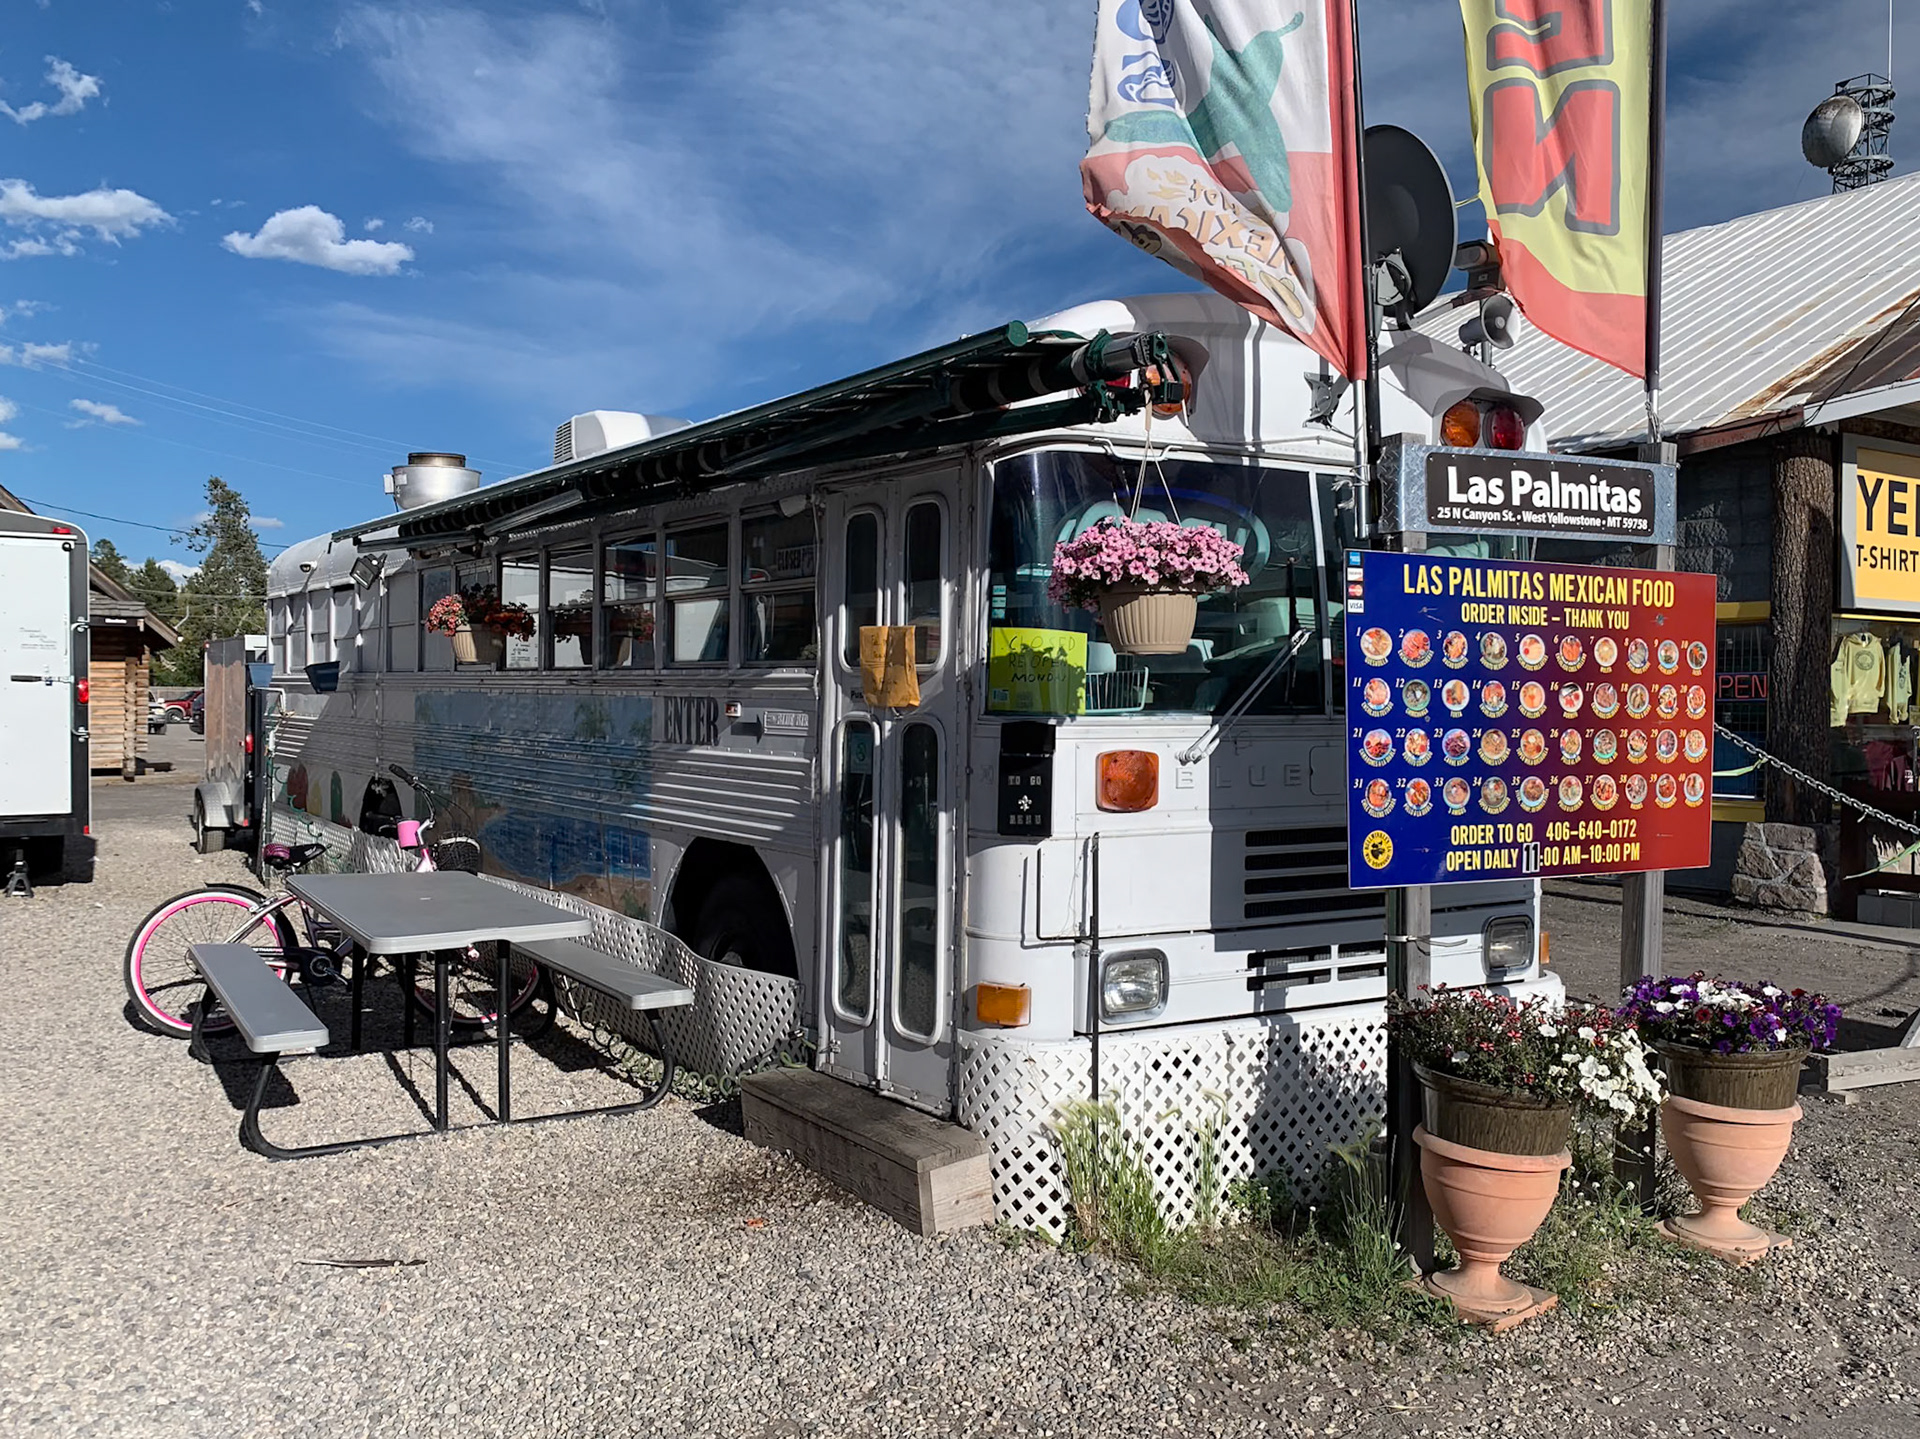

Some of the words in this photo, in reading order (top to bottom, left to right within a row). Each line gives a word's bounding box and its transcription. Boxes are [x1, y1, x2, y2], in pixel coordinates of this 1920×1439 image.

[1447, 466, 1505, 506] Las
[1511, 470, 1642, 515] Palmitas
[1437, 507, 1451, 518] 25
[1452, 508, 1460, 519] N
[1462, 508, 1501, 524] Canyon
[1502, 509, 1516, 521] St.
[1522, 511, 1546, 524] West
[1547, 512, 1602, 527] Yellowstone
[1607, 516, 1622, 528] MT
[1622, 518, 1648, 530] 59758
[1404, 564, 1443, 596] LAS
[1449, 566, 1544, 600] PALMITAS
[1549, 573, 1628, 605] MEXICAN
[1632, 578, 1674, 608] FOOD
[1350, 602, 1364, 610] VISA
[1461, 602, 1505, 624] ORDER
[1508, 604, 1548, 626] INSIDE
[1564, 607, 1604, 628] THANK
[1606, 610, 1630, 630] YOU
[1356, 627, 1362, 636] 1
[1399, 628, 1404, 638] 2
[1436, 630, 1442, 640] 3
[1475, 632, 1481, 640] 4
[1514, 633, 1520, 642] 5
[1554, 635, 1559, 644] 6
[1590, 636, 1594, 645] 7
[1654, 638, 1658, 648] 9
[1352, 677, 1362, 687] 11
[1396, 678, 1404, 688] 12
[1433, 679, 1442, 688] 13
[1472, 680, 1482, 690] 14
[1511, 680, 1520, 690] 15
[1550, 682, 1558, 690] 16
[1586, 682, 1594, 691] 17
[1716, 674, 1767, 698] PEN
[1651, 684, 1659, 692] 19
[664, 696, 721, 746] ENTER
[1352, 728, 1362, 738] 21
[1396, 728, 1406, 738] 22
[1434, 728, 1444, 738] 23
[1472, 728, 1482, 738] 24
[1511, 728, 1520, 738] 25
[1550, 728, 1558, 738] 26
[1585, 728, 1594, 738] 27
[1650, 728, 1658, 738] 29
[1008, 775, 1021, 786] TO
[1030, 775, 1042, 786] GO
[1354, 778, 1363, 788] 31
[1396, 778, 1406, 788] 32
[1434, 777, 1444, 787] 33
[1472, 776, 1482, 786] 34
[1511, 776, 1521, 786] 35
[1550, 775, 1558, 784] 36
[1584, 774, 1594, 784] 37
[1650, 774, 1658, 782] 39
[1450, 824, 1494, 846] ORDER
[1497, 822, 1514, 844] TO
[1516, 822, 1534, 843] GO
[1446, 850, 1481, 872] OPEN
[1484, 848, 1519, 870] DAILY
[1524, 843, 1560, 872] 11:00
[1622, 842, 1640, 862] PM
